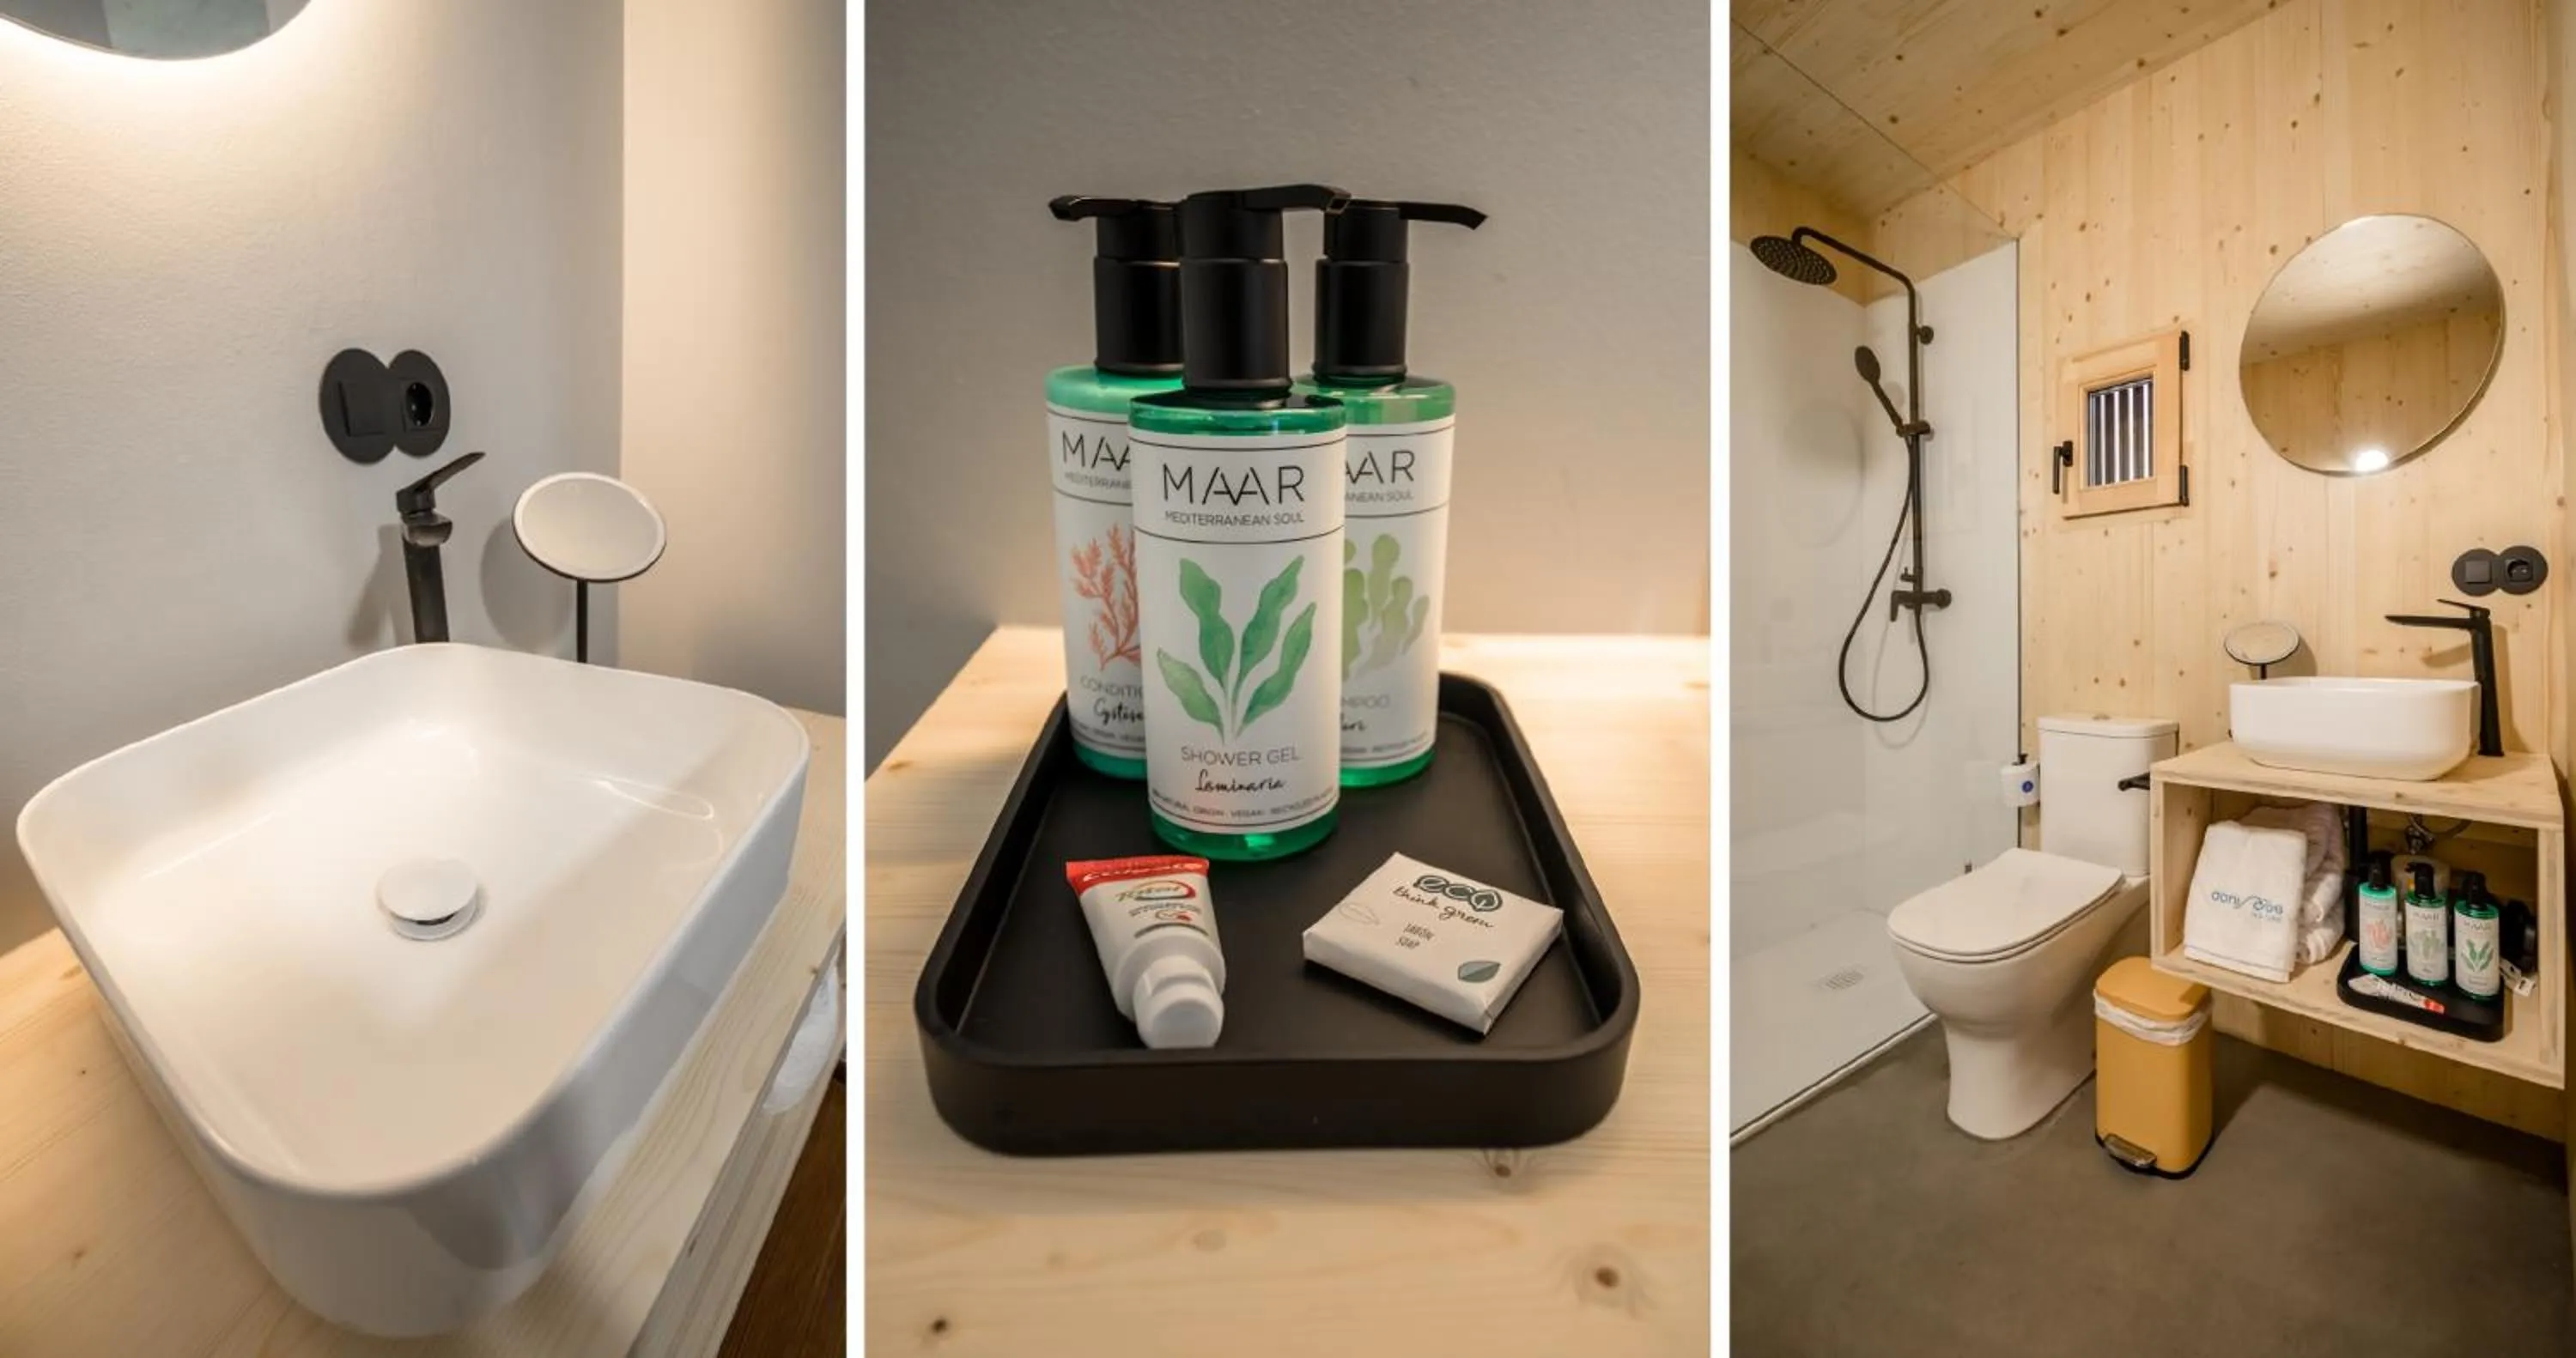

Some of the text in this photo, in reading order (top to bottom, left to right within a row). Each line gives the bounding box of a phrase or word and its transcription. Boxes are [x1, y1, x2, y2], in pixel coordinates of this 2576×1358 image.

[1062, 430, 1131, 471] MAA
[1345, 451, 1415, 484] AAR
[1163, 464, 1304, 506] MAAR
[1165, 511, 1305, 526] MEDITERRANEAN SOUL
[1181, 746, 1303, 767] SHOWER GEL
[1392, 885, 1496, 929] think green
